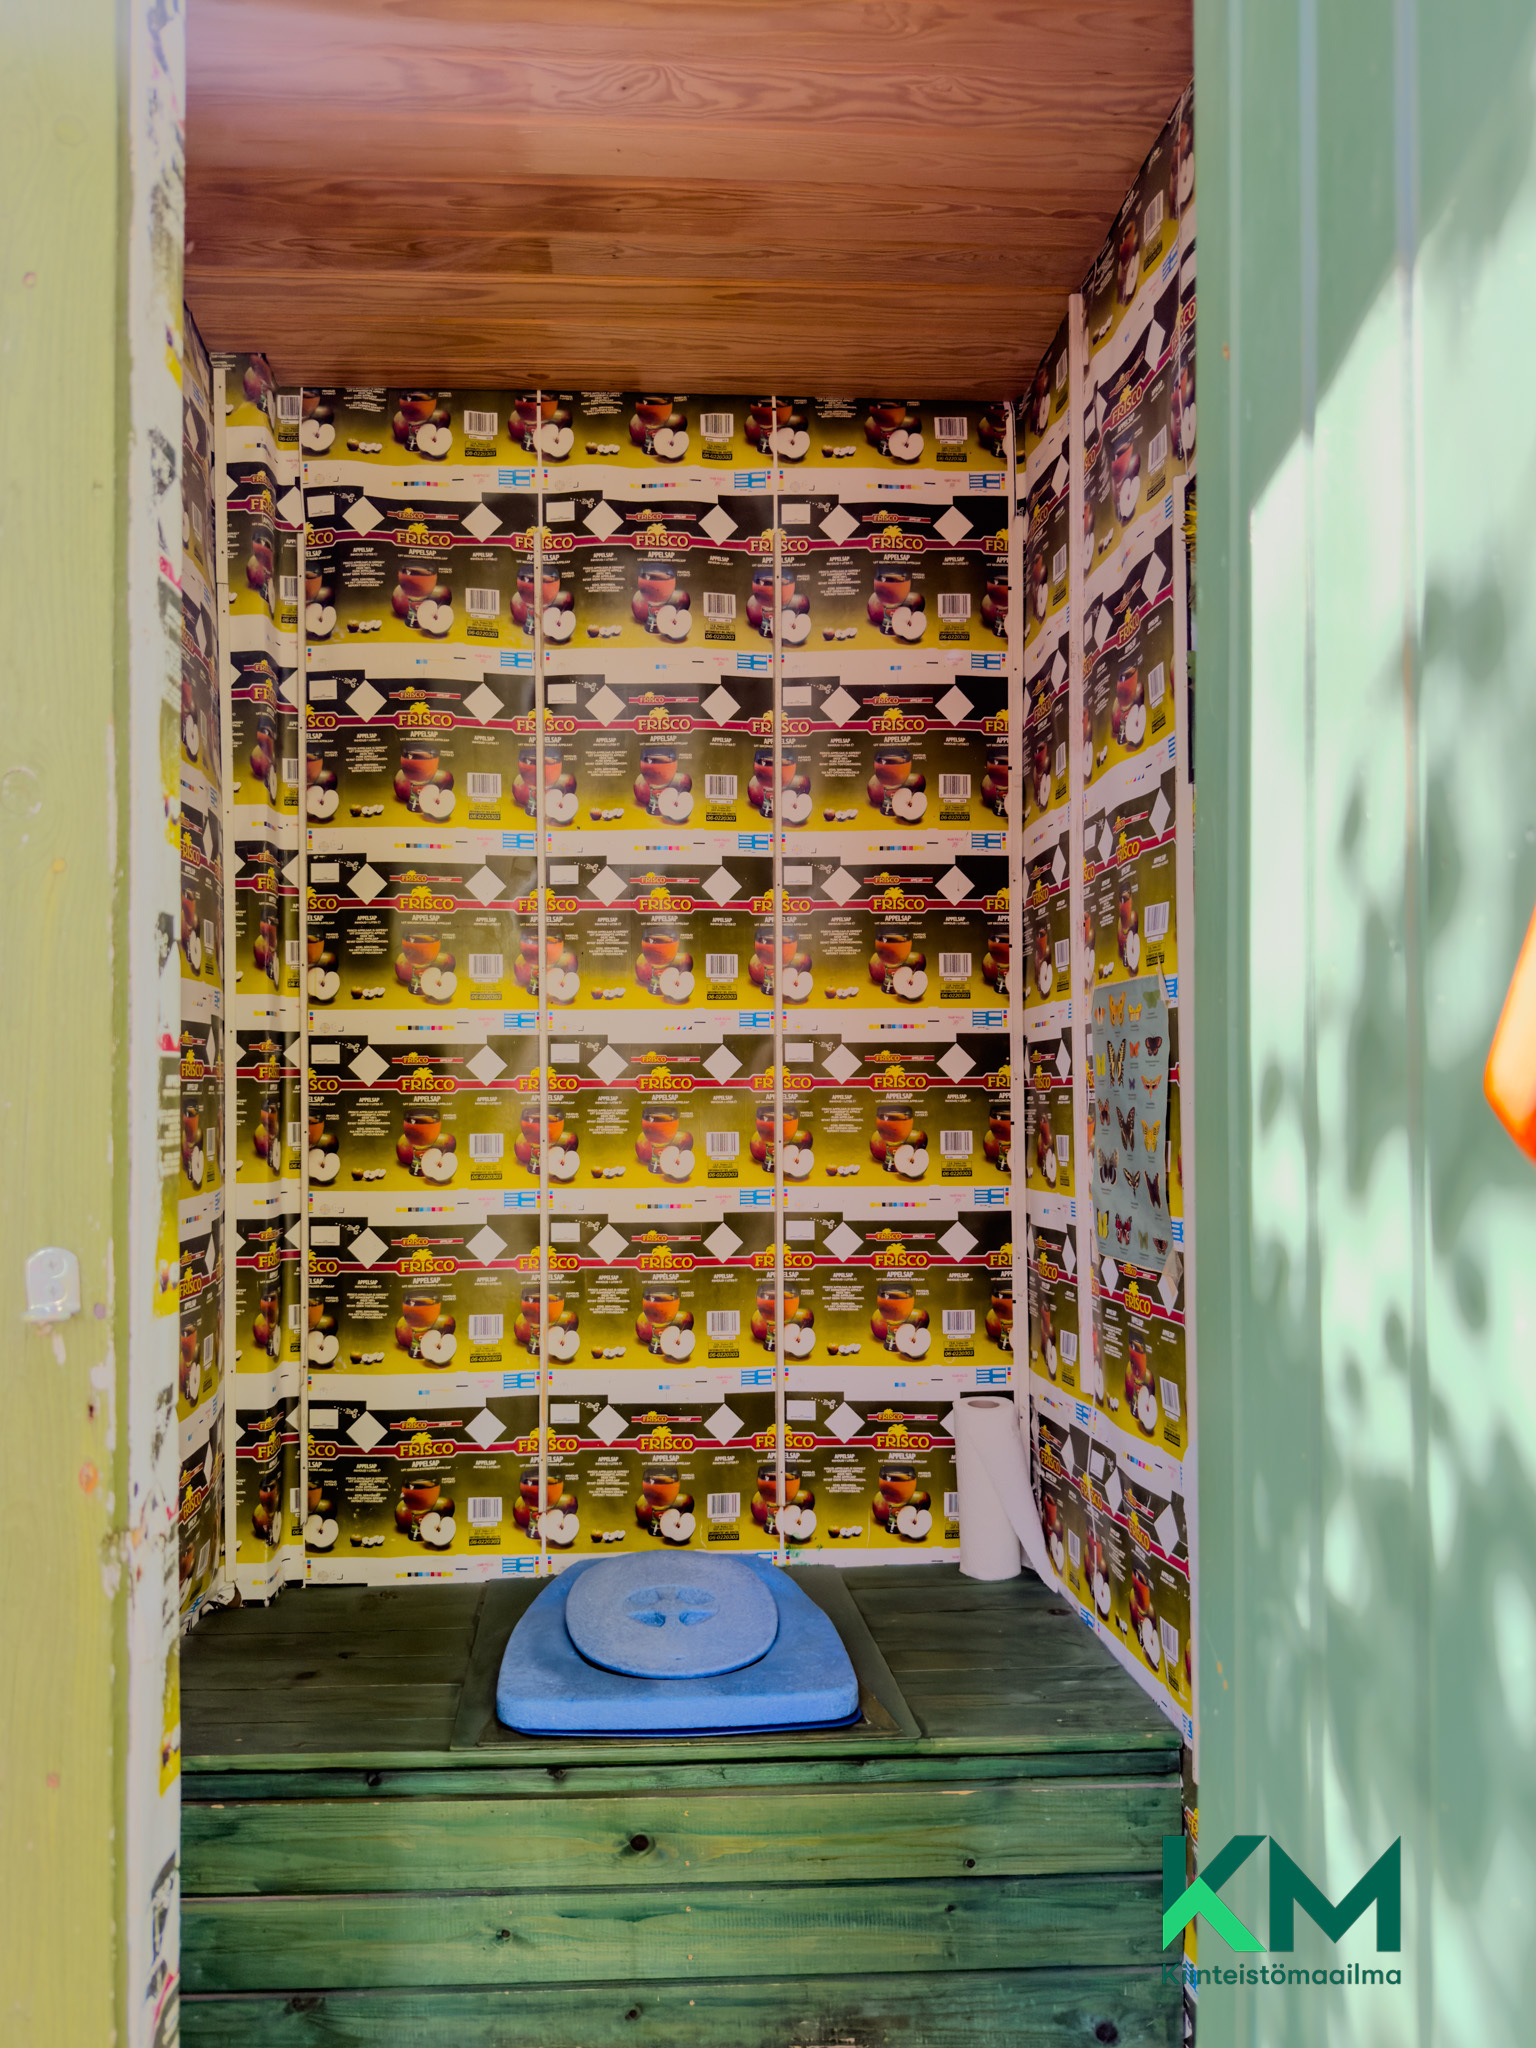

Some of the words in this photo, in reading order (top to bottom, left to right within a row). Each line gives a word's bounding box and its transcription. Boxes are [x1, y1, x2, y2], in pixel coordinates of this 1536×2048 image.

[1112, 386, 1142, 424] FRISCO
[398, 533, 450, 547] FRISCO
[636, 536, 688, 547] FRISCO
[872, 538, 925, 550] FRISCO
[408, 548, 437, 557] APPELSAP
[1118, 612, 1140, 644] FRISCO
[399, 714, 452, 726] FRISCO
[638, 720, 690, 731] FRISCO
[872, 720, 925, 732] FRISCO
[1116, 841, 1140, 863] FRISCO
[401, 898, 454, 910] FRISCO
[639, 900, 691, 911] FRISCO
[873, 899, 926, 911] FRISCO
[182, 1063, 203, 1077] FRISCO
[402, 1079, 455, 1091] FRISCO
[640, 1078, 692, 1090] FRISCO
[874, 1077, 927, 1089] FRISCO
[401, 1261, 454, 1273] FRISCO
[641, 1258, 693, 1269] FRISCO
[875, 1255, 928, 1267] FRISCO
[1124, 1293, 1151, 1315] FRISCO
[641, 1438, 693, 1450] FRISCO
[877, 1437, 930, 1449] FRISCO
[400, 1444, 453, 1456] FRISCO
[1041, 1450, 1062, 1476] FRISCO
[1128, 1518, 1151, 1551] FRISCO
